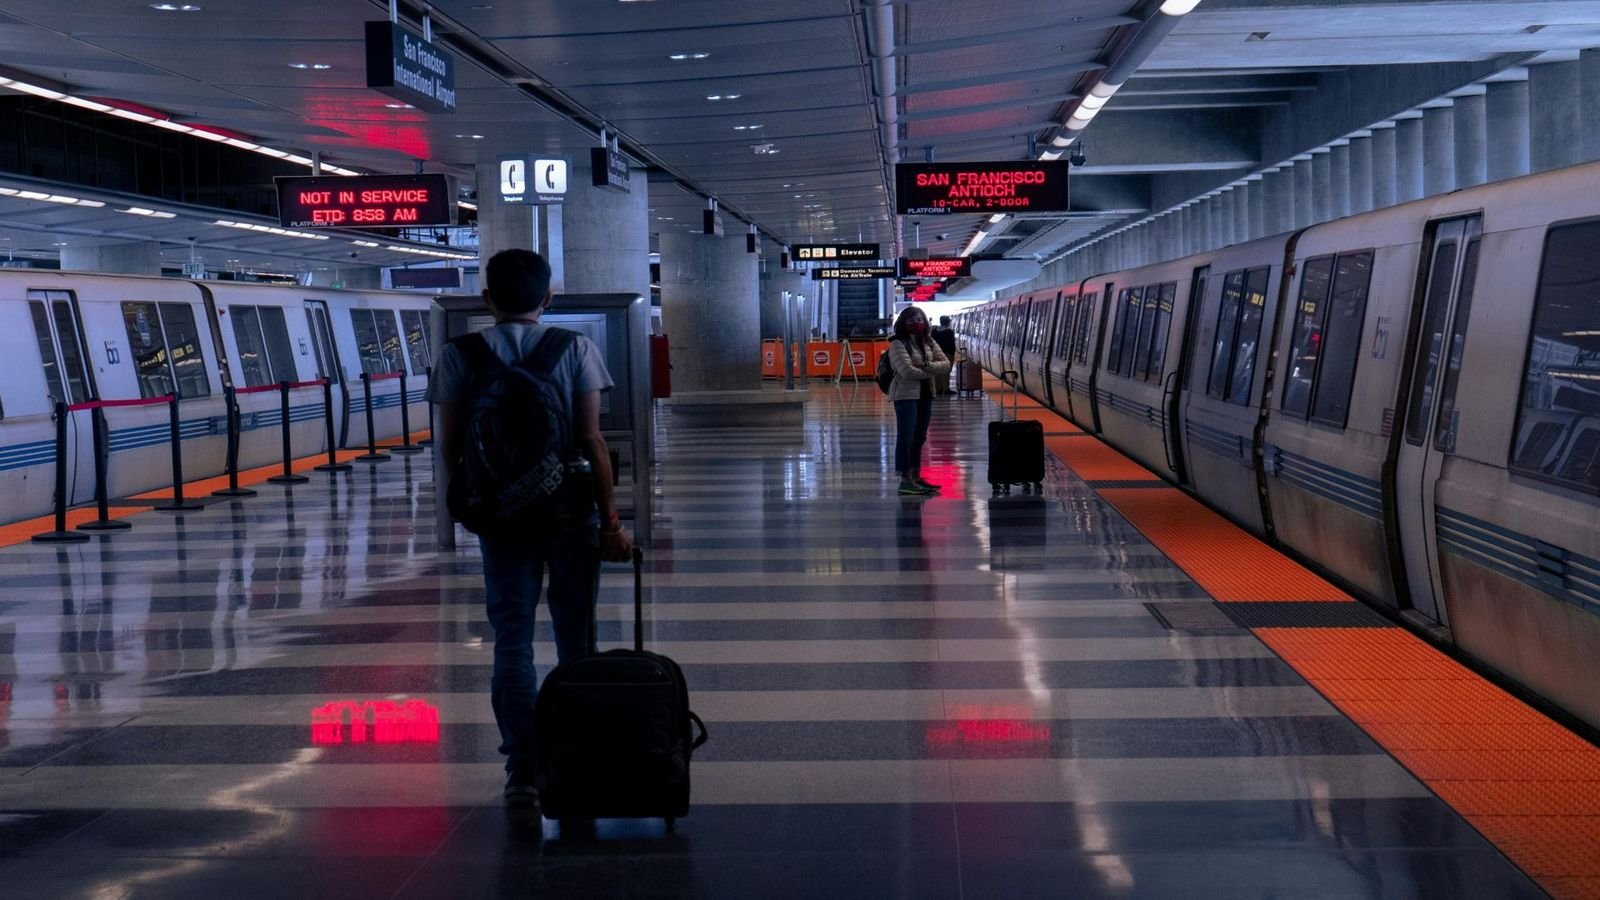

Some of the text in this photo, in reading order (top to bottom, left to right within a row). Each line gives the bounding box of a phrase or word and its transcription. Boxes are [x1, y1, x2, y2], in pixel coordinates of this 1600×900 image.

[404, 34, 446, 77] San Francisco
[394, 57, 456, 108] International Airport
[916, 171, 1045, 185] SAN FRANCISCO
[300, 190, 428, 204] NOT IN SERVICE
[949, 184, 1015, 197] ANTIOCH
[986, 197, 1029, 206] 2-DOOR
[313, 208, 416, 222] ETD: 8:58 AM
